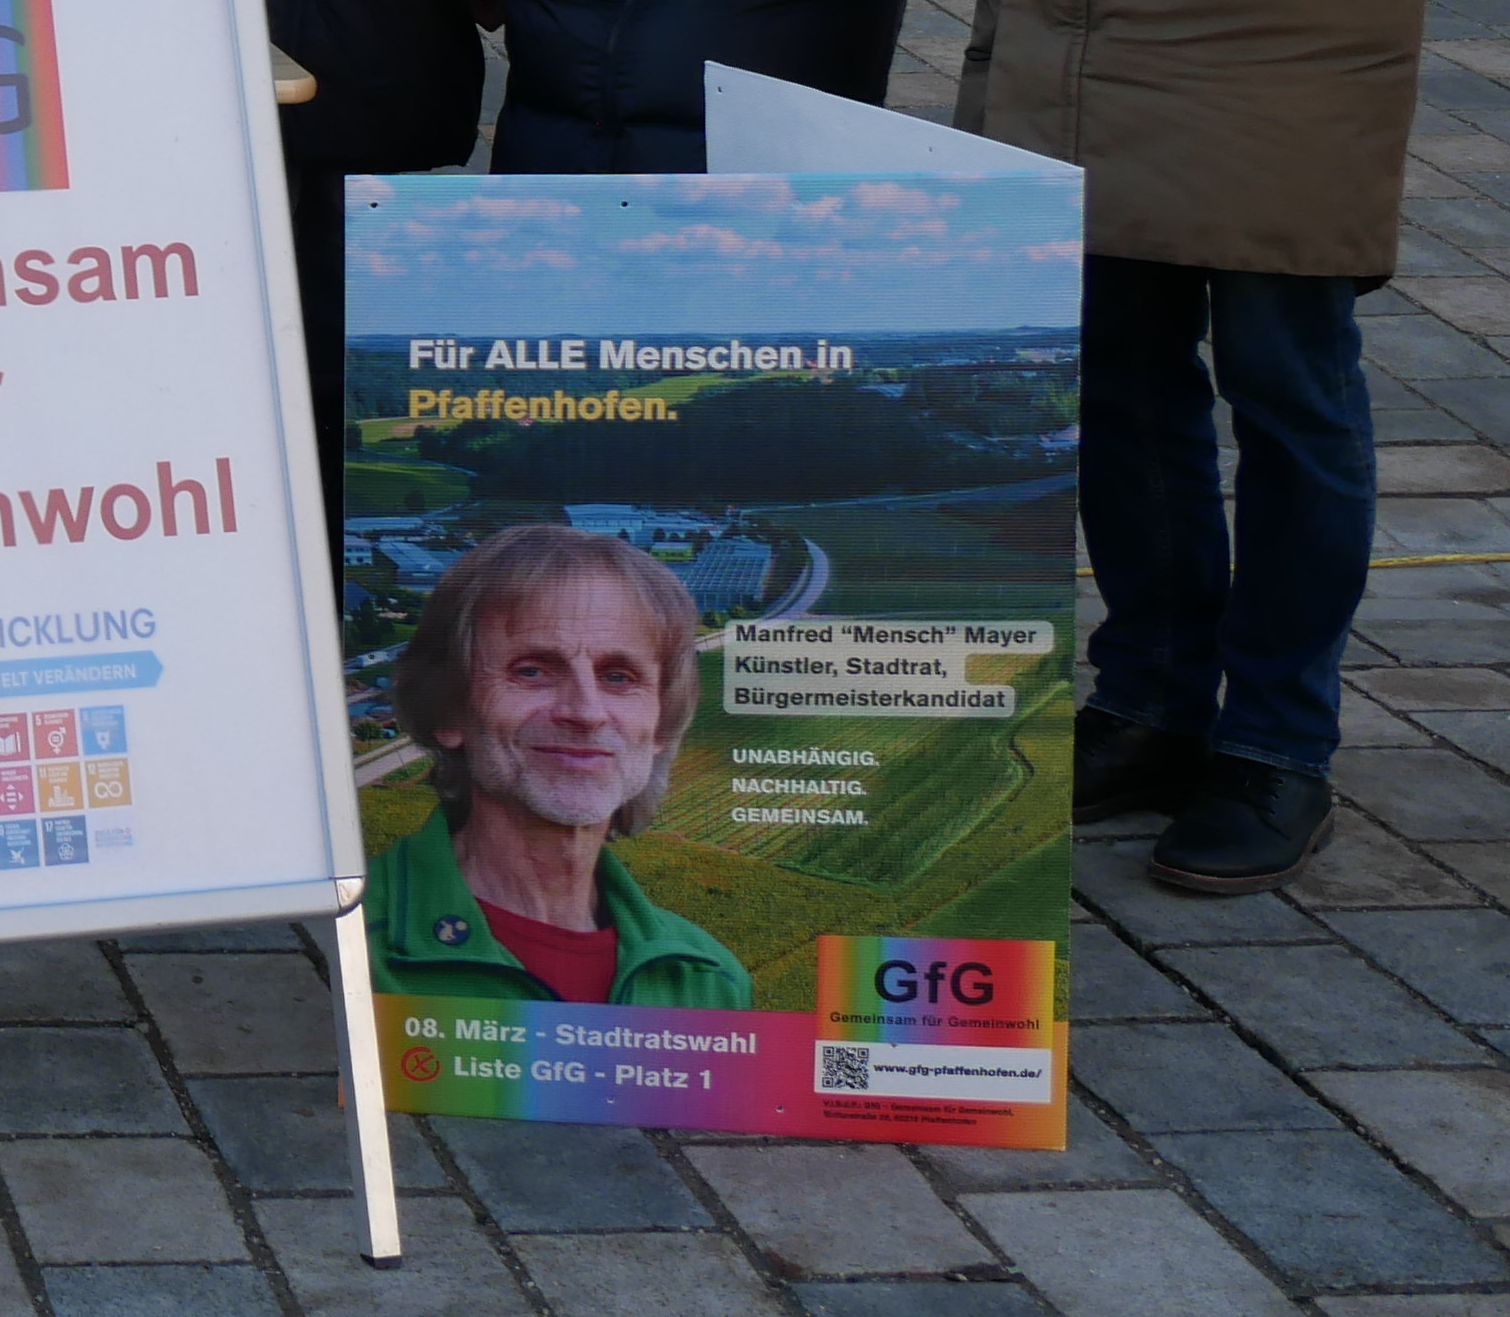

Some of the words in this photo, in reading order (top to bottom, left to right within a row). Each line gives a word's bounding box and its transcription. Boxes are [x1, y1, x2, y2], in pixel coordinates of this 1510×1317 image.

[408, 339, 475, 370] Für
[485, 339, 587, 370] ALLE
[599, 339, 802, 370] Menschen
[817, 339, 853, 370] in
[408, 388, 678, 422] Pfaffenhofen.
[735, 623, 833, 643] Manfred
[964, 626, 1038, 648] Mayer
[33, 663, 137, 685] VERÄNDERN
[734, 656, 838, 678] Künstler,
[845, 657, 948, 679] Stadtrat,
[734, 687, 1006, 710] Bürgermeisterkandidat
[731, 745, 880, 767] UNABHÄNGIG.
[731, 777, 868, 796] NACHHALTIG.
[731, 807, 870, 827] GEMEINSAM.
[874, 959, 995, 1006] GfG
[829, 1011, 917, 1027] Gemeinsam
[921, 1014, 943, 1027] für
[948, 1016, 1040, 1030] Gemeinwohl
[404, 1017, 445, 1038] 08.
[454, 1019, 527, 1043] März
[554, 1023, 757, 1054] Stadtratswahl
[453, 1056, 523, 1079] Liste
[530, 1060, 586, 1083] GfG
[615, 1064, 689, 1089] Platz
[699, 1070, 712, 1089] 1
